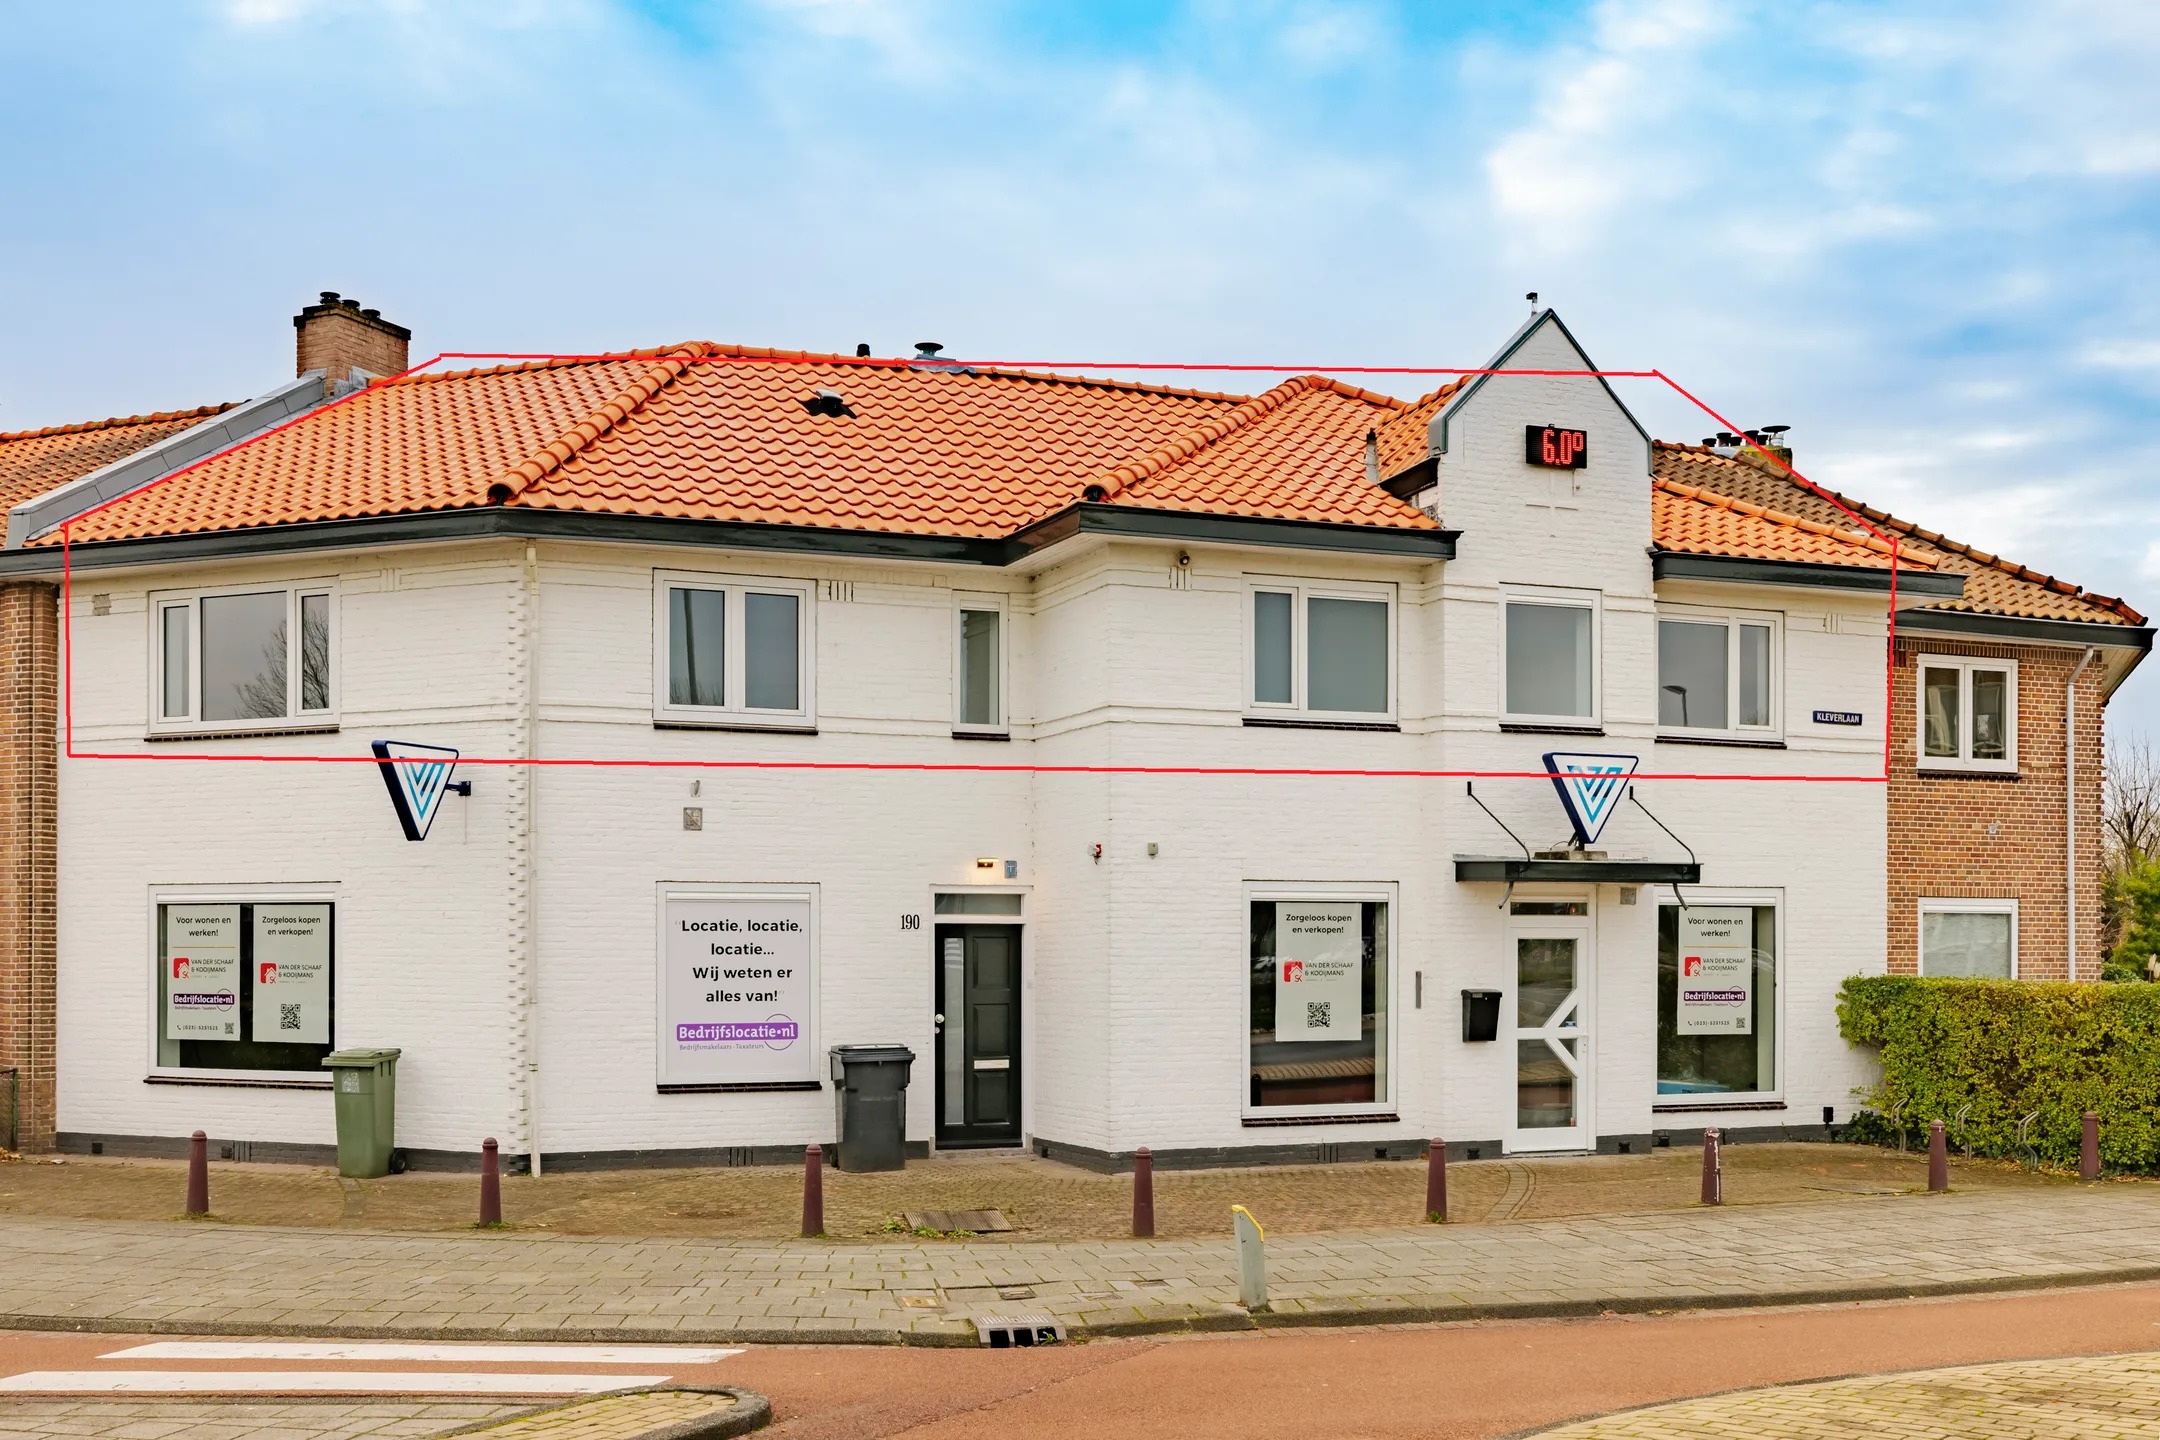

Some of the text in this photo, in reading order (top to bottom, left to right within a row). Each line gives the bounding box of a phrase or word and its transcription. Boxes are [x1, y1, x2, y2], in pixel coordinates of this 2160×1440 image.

[1816, 712, 1860, 723] KLEVERLAAN
[175, 916, 193, 924] Voor
[262, 916, 321, 925] Zorgeloos kopen
[900, 913, 921, 930] 190
[1286, 914, 1352, 923] Zorgeloos kopen
[1687, 917, 1705, 925] Voor
[747, 918, 803, 933] locatie,
[1292, 926, 1344, 934] en verkopen!
[278, 928, 314, 937] verkopen!
[1700, 929, 1731, 937] werken!
[711, 942, 775, 956] locatie...
[692, 965, 793, 981] Wij weten er
[705, 989, 742, 1003] alles
[679, 1043, 732, 1051] Bedrijfsmakelaars
